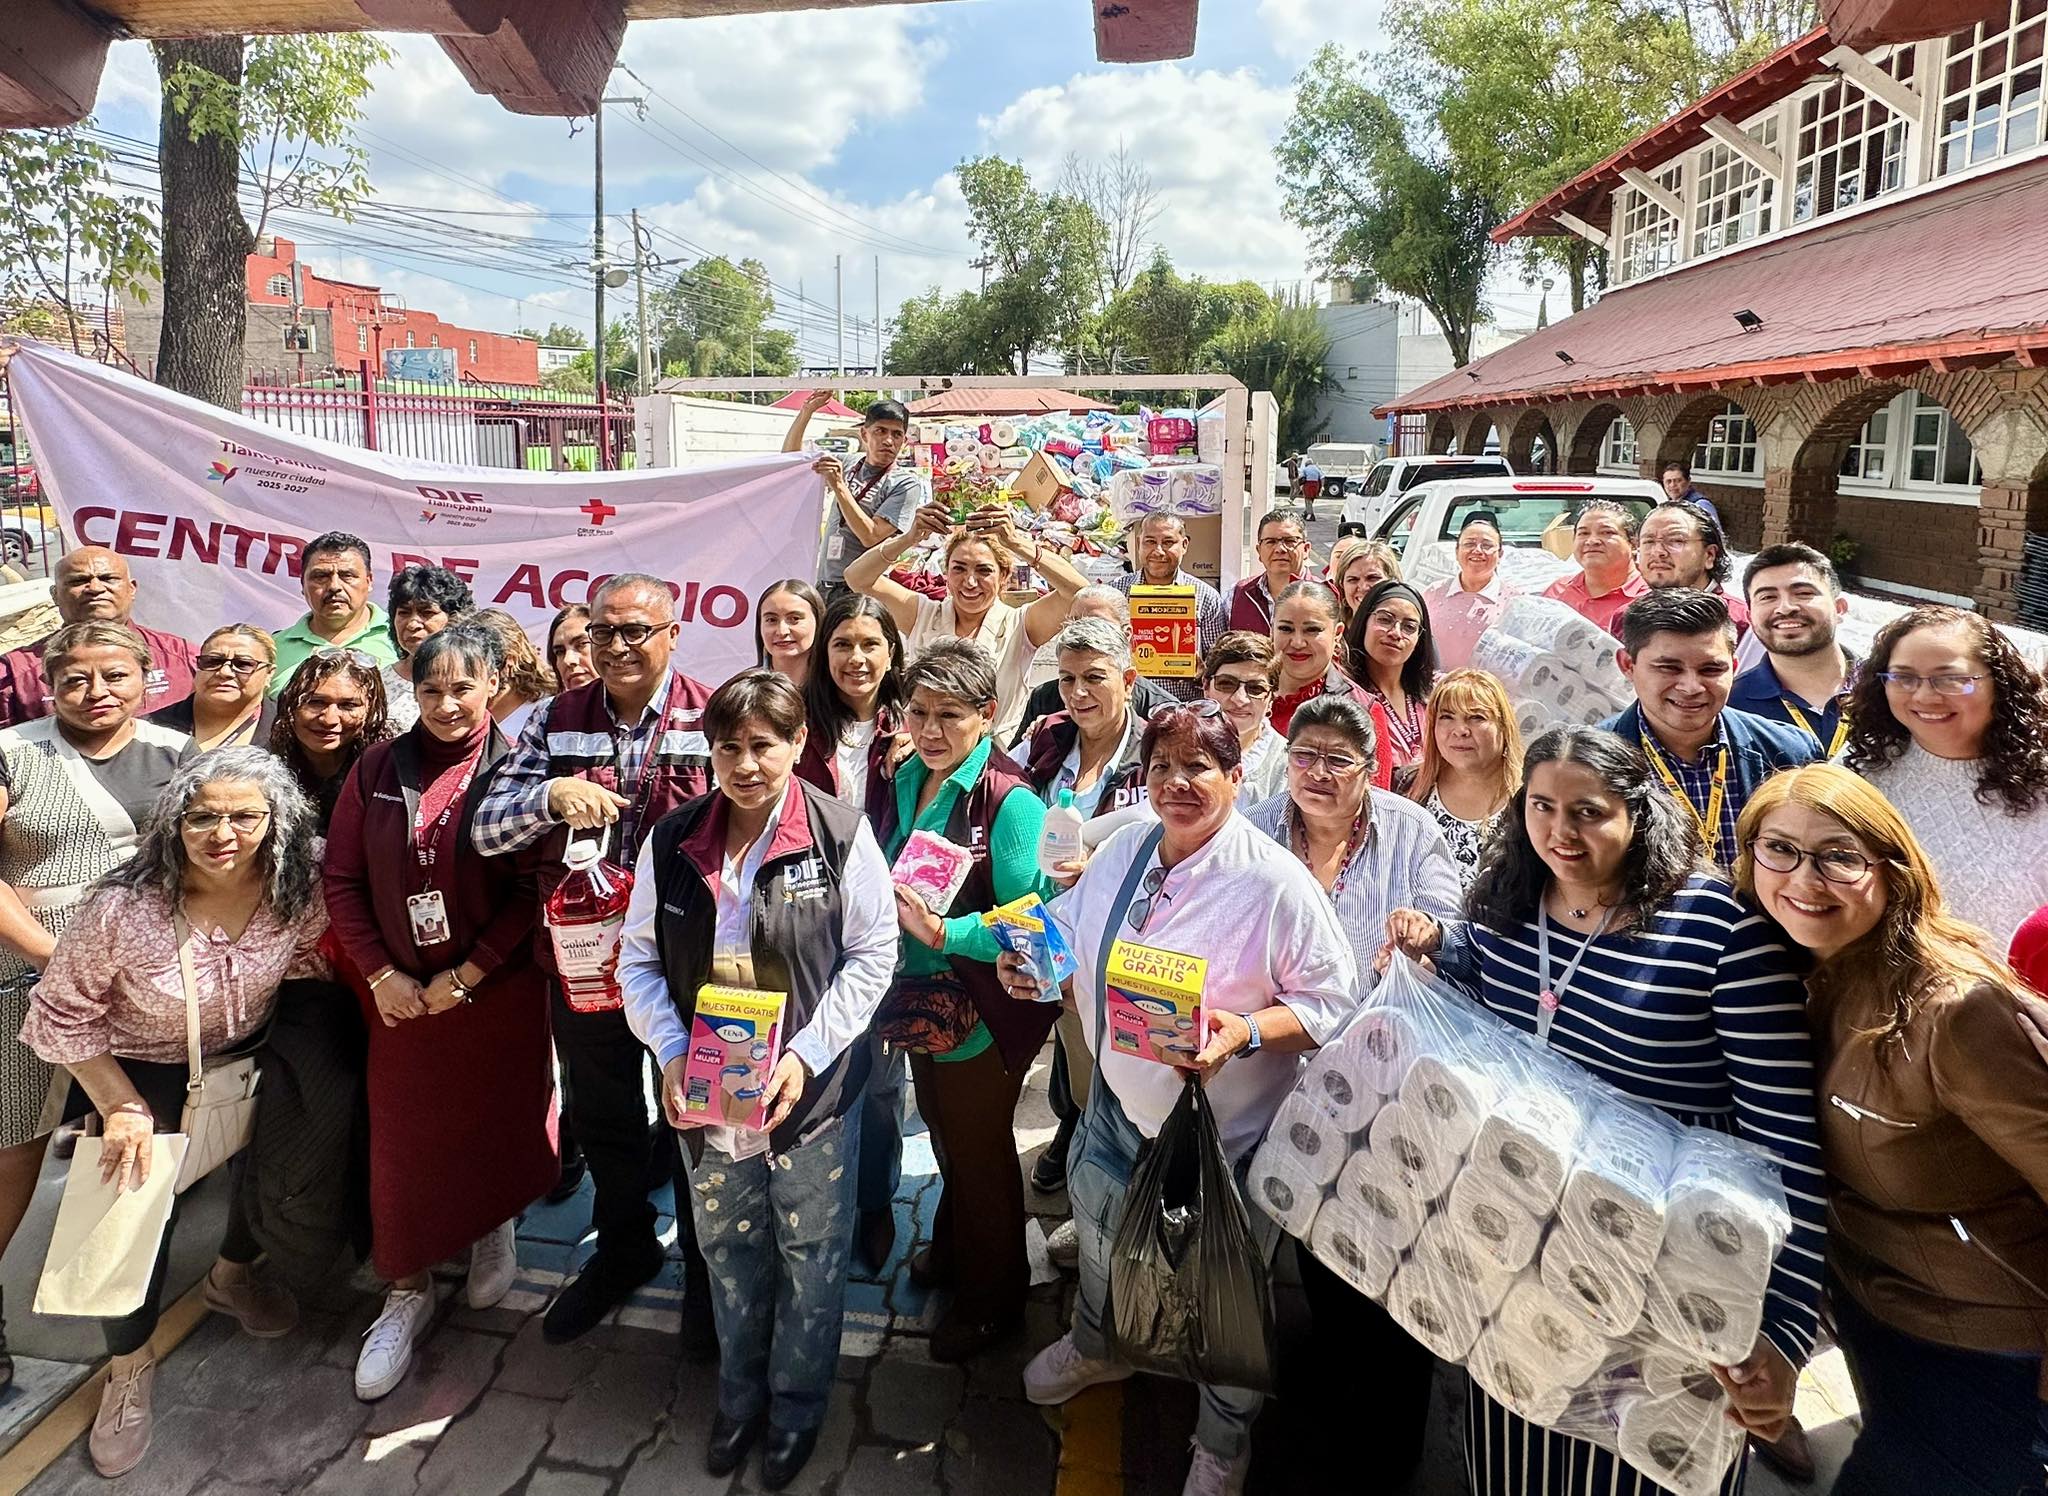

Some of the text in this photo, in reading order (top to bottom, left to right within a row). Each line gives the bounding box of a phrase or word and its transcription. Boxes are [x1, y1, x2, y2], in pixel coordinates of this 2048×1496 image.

[245, 466, 326, 486] nuestra ciudad
[416, 486, 483, 503] DIF
[73, 506, 308, 578] CENTR
[492, 563, 749, 628] ACIO
[1193, 562, 1213, 571] Fortec
[1138, 648, 1149, 658] 20
[439, 808, 451, 825] DIF
[418, 849, 427, 866] DIF
[784, 857, 823, 884] DIF
[561, 939, 600, 950] Golden
[568, 948, 594, 958] Hills
[1118, 946, 1198, 973] MUESTRA
[1123, 960, 1184, 983] GRATIS
[1112, 977, 1194, 1003] MUESTRA GRATIS
[701, 1001, 774, 1018] MUESTRA GRATIS
[1141, 1003, 1164, 1012] TENA
[723, 1029, 743, 1038] TENA
[695, 1055, 720, 1064] MUJER
